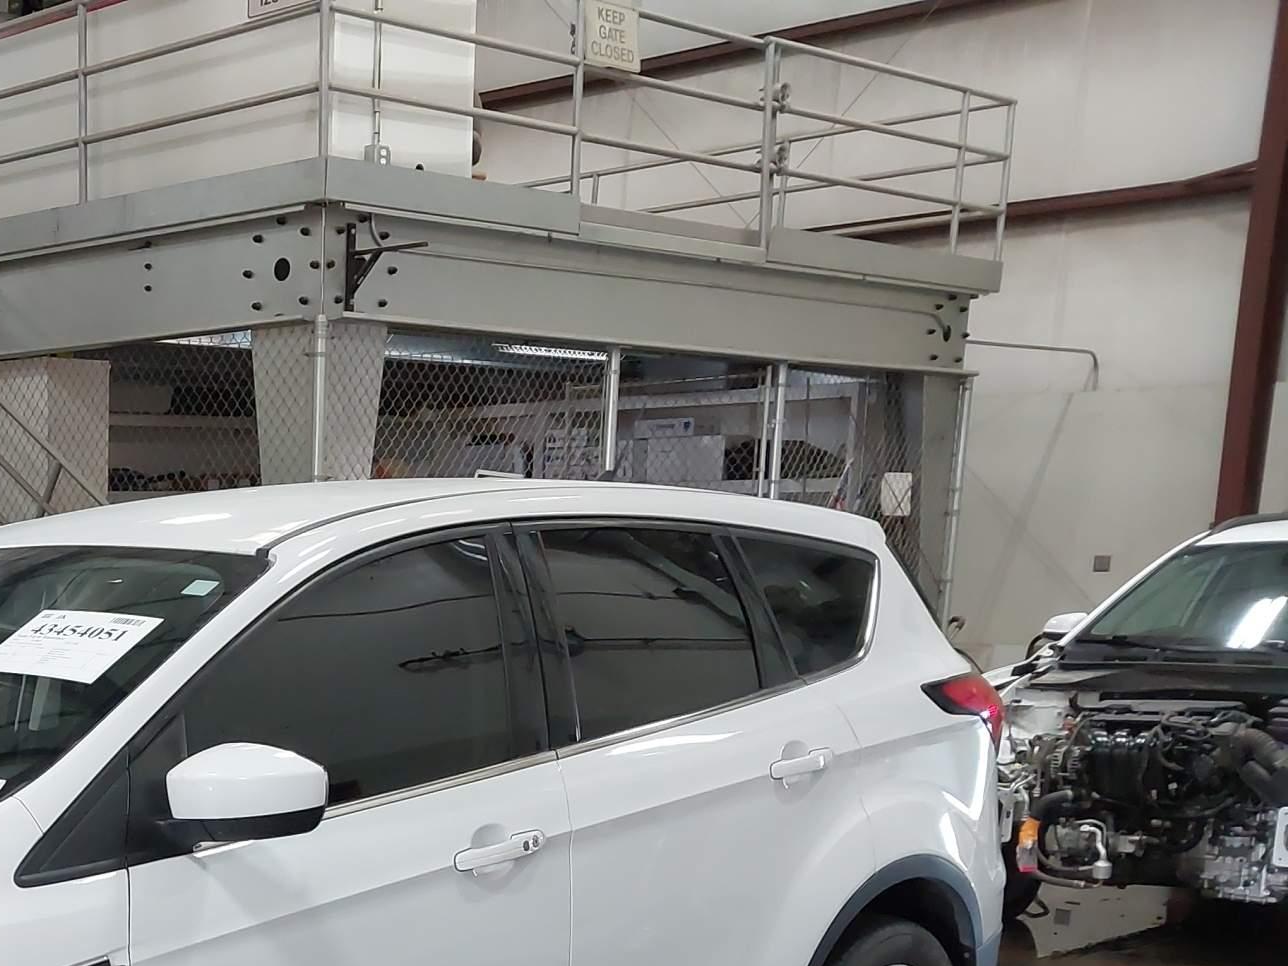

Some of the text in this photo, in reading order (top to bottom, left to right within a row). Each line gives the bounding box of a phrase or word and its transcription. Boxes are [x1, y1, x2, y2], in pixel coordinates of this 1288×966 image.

[597, 7, 626, 25] KEEP
[599, 25, 626, 44] GATE
[591, 40, 634, 63] CLOSED
[31, 622, 129, 642] 43454051
